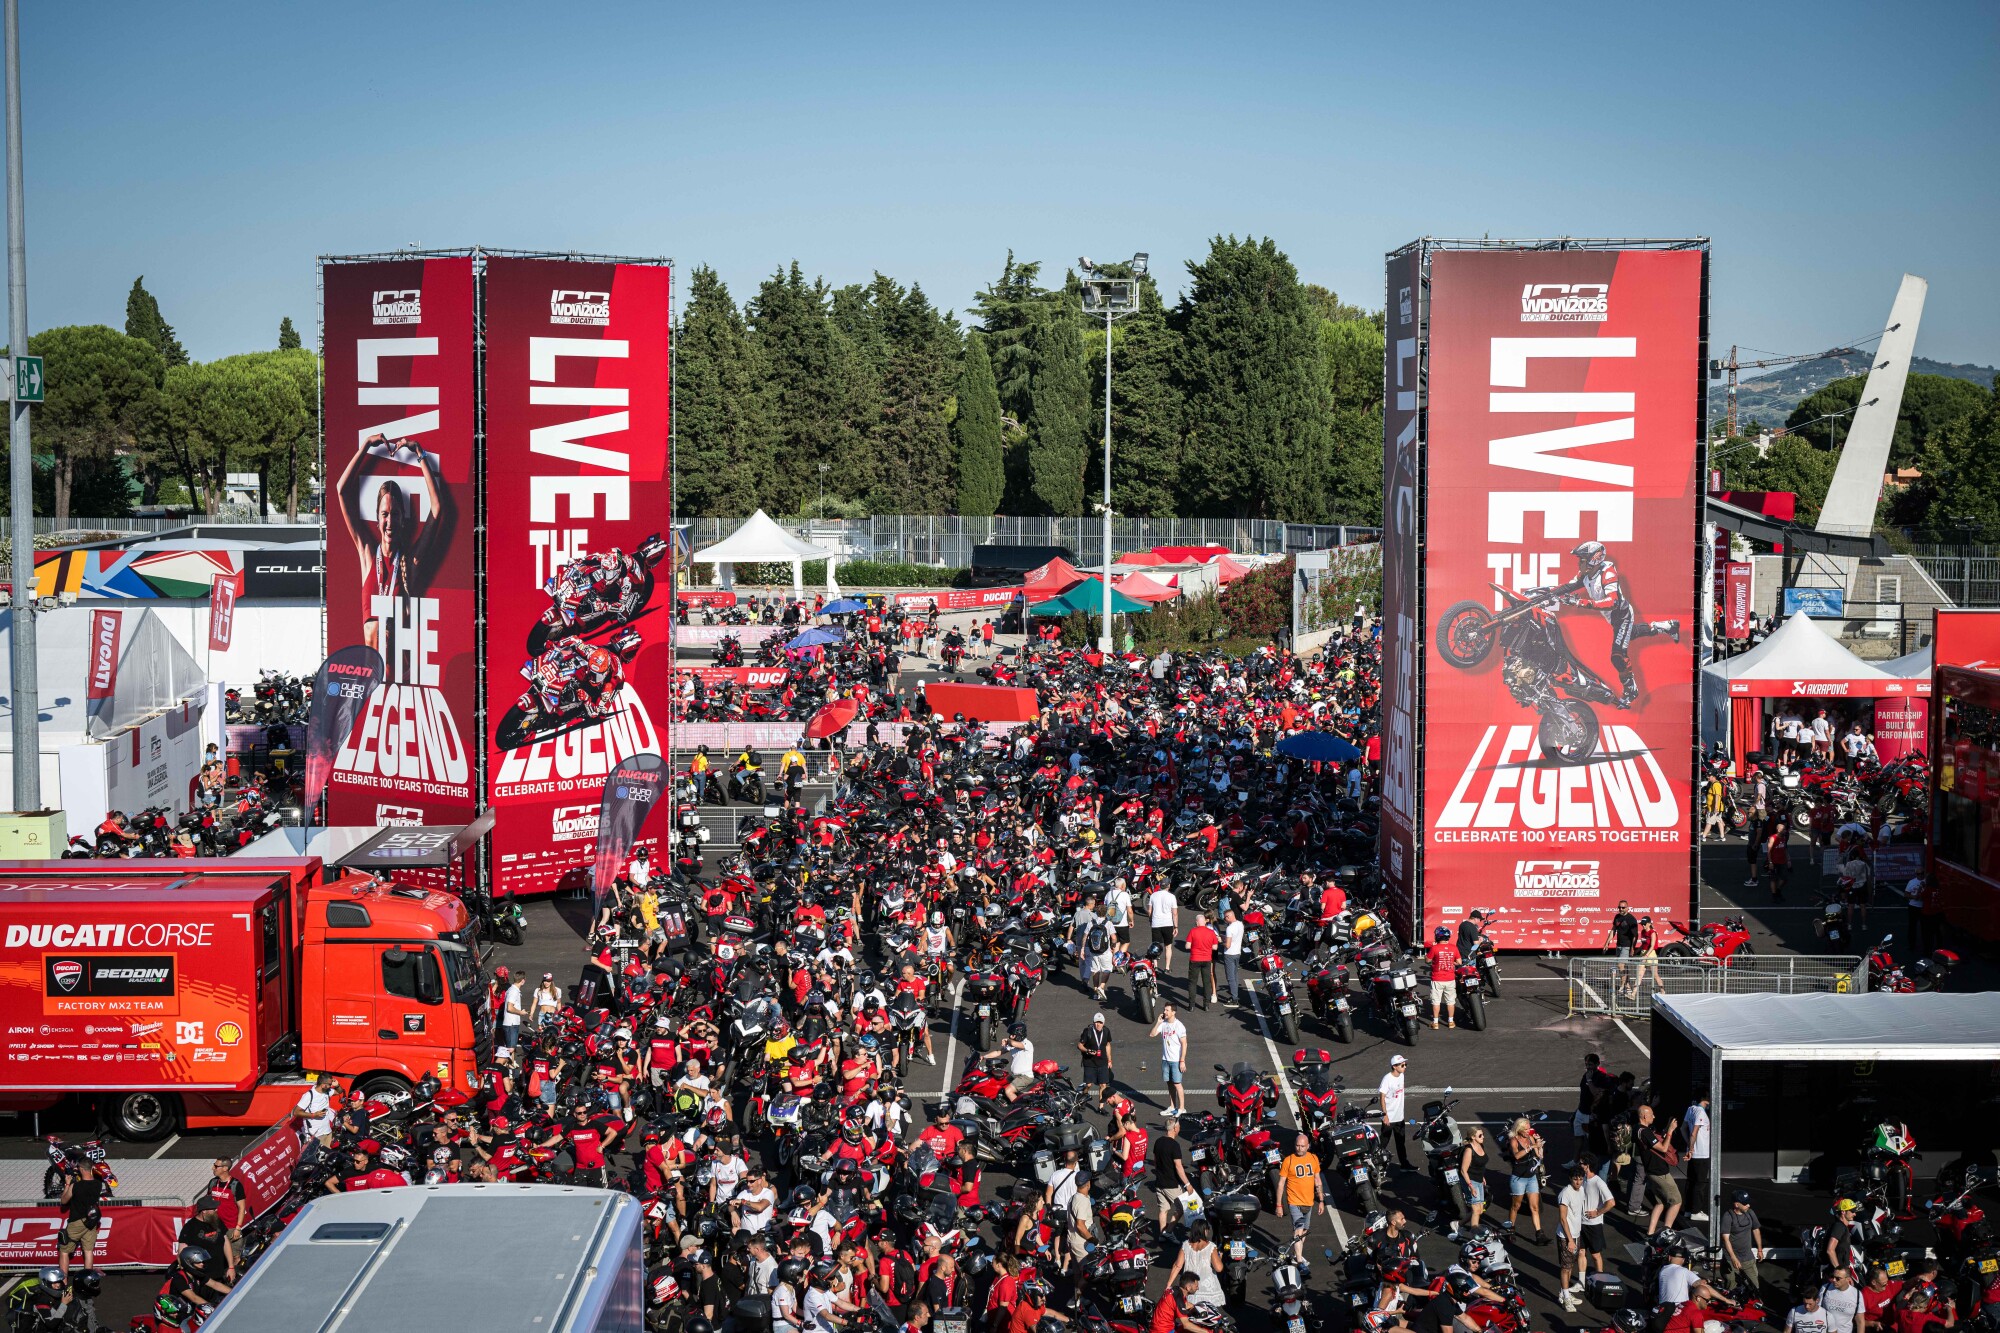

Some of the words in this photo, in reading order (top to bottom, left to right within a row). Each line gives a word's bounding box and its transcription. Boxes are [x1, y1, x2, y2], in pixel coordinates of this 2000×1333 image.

[373, 302, 421, 316] WDW2026
[551, 303, 609, 317] WDW2026
[1522, 299, 1607, 313] WDW2026
[357, 337, 440, 523] LIVE
[529, 336, 630, 523] LIVE
[1487, 337, 1637, 544] LIVE
[983, 592, 1012, 602] DUCATI
[371, 595, 439, 686] THE
[95, 615, 116, 689] DUCATI
[328, 664, 373, 678] DUCATI
[340, 690, 364, 699] LOCK
[341, 683, 364, 693] QUAD
[1807, 682, 1849, 694] AKRAPOVIČ
[1877, 711, 1922, 719] PARTNERSHIP
[1886, 721, 1904, 729] BUILT
[333, 683, 468, 784] LEGEND
[1877, 730, 1924, 739] PERFORMANCE
[617, 769, 658, 783] DUCATI
[1434, 725, 1679, 829] LEGEND
[333, 772, 378, 787] CELEBRATE
[379, 777, 393, 790] 100
[393, 779, 422, 793] YEARS
[423, 781, 469, 798] TOGETHER
[495, 783, 555, 797] CELEBRATE
[557, 780, 574, 791] 100
[575, 777, 607, 789] YEARS
[630, 787, 652, 796] QUAD
[629, 793, 650, 802] LOCK
[1434, 831, 1518, 842] CELEBRATE
[1522, 831, 1545, 842] 100
[1548, 831, 1596, 842] YEARS
[1600, 831, 1679, 842] TOGETHER
[1514, 874, 1600, 888] WDW2026
[5, 924, 126, 947] DUCATI
[127, 923, 214, 946] CORSE
[95, 968, 169, 978] BEDDINI
[8, 1026, 34, 1034] AIROH
[131, 1021, 163, 1034] Milwaukee
[1295, 1163, 1313, 1178] 01
